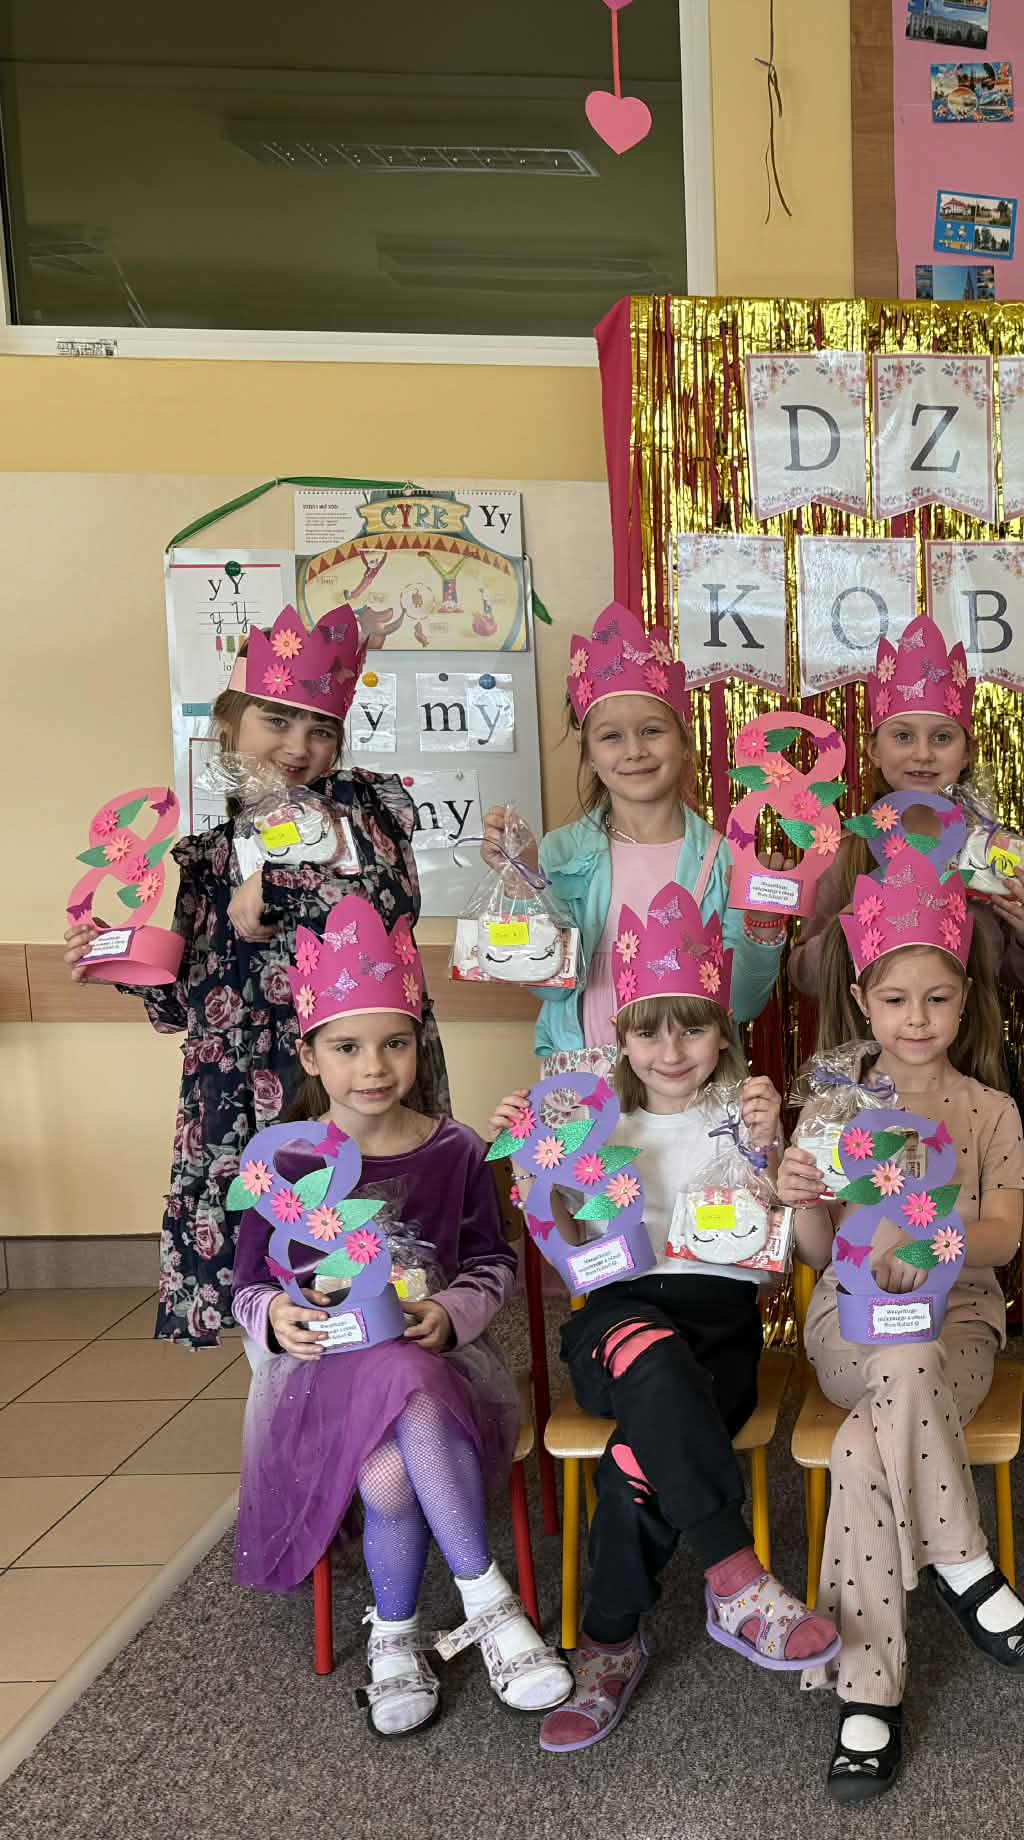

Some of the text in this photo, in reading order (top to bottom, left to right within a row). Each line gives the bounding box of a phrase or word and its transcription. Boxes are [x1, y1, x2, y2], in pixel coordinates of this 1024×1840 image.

[380, 503, 450, 530] CYRK
[358, 702, 389, 744] y
[420, 701, 506, 746] my
